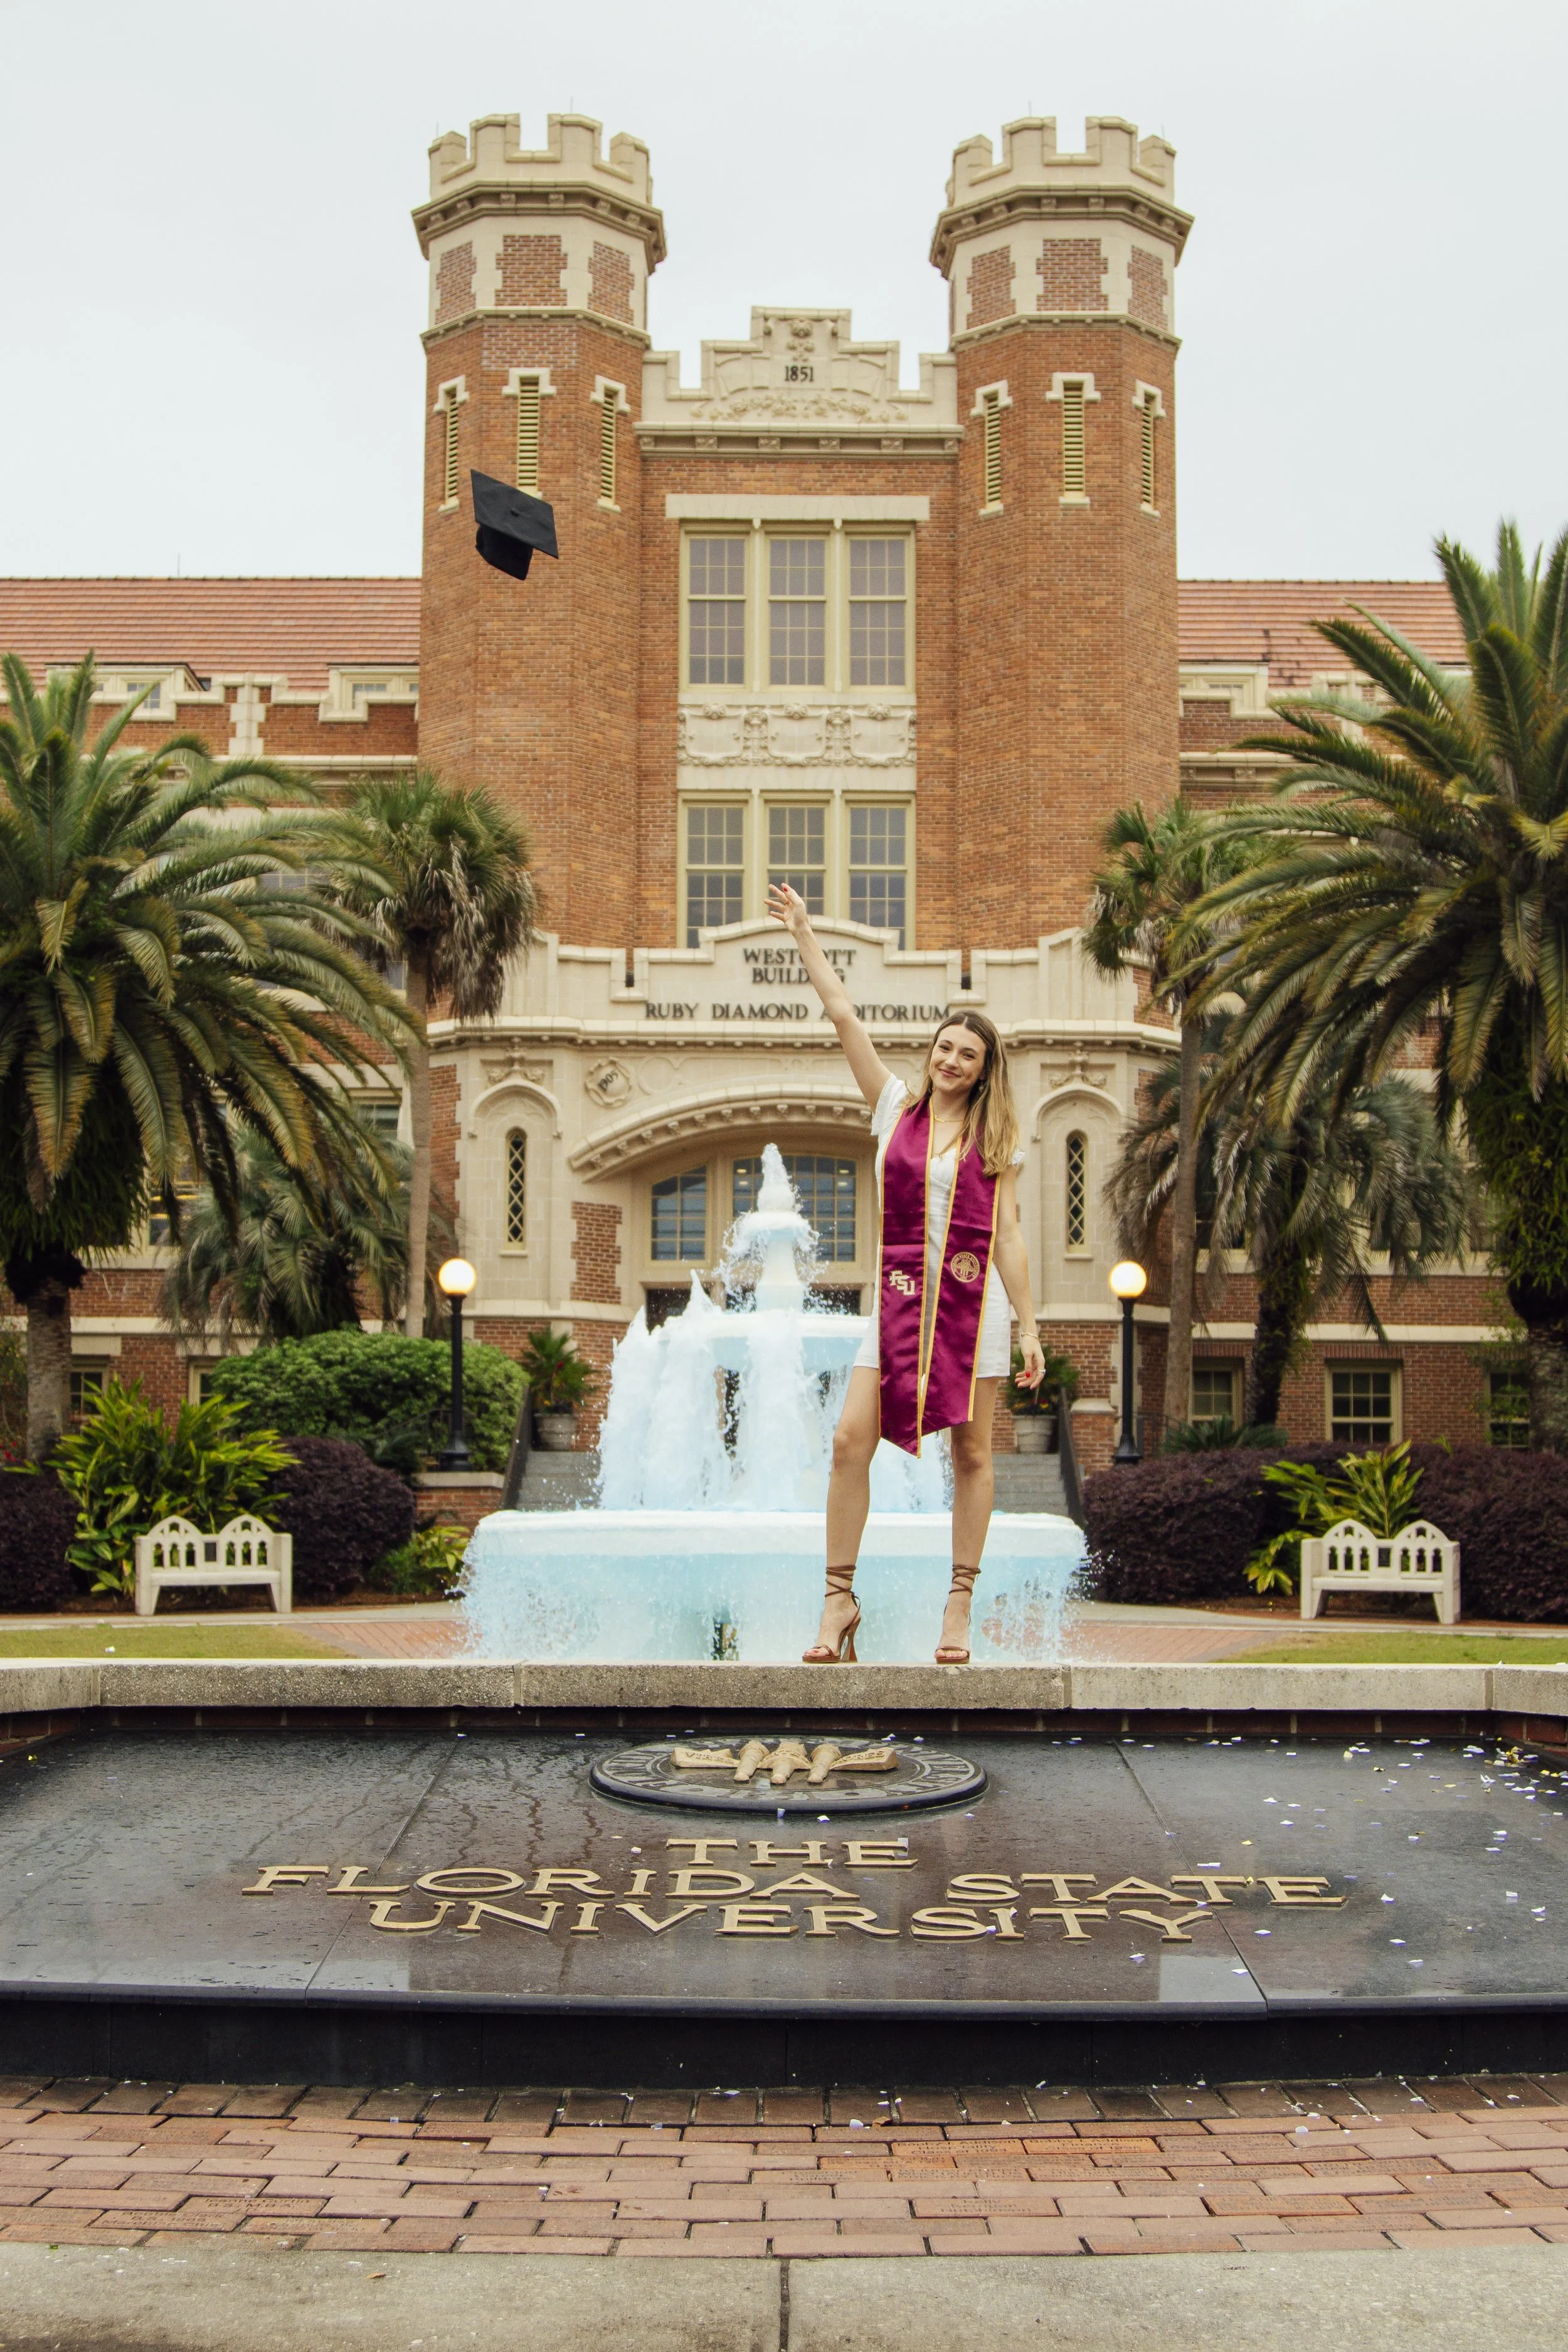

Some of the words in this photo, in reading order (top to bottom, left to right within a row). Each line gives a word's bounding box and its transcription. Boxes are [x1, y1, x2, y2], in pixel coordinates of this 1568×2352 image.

[785, 366, 814, 382] 1851
[743, 948, 857, 966] WESTTT
[751, 967, 845, 984] BUILDG
[645, 1003, 699, 1019] RUBY
[712, 1003, 808, 1020] DIAMOND
[819, 1004, 950, 1021] ADITORIUM
[889, 1270, 916, 1296] FSU
[717, 1789, 820, 1801] 1851
[665, 1838, 918, 1869] THE
[241, 1865, 860, 1901] FLORIDA
[946, 1873, 1348, 1907] STATE
[369, 1900, 1213, 1942] UNIVERSITY
